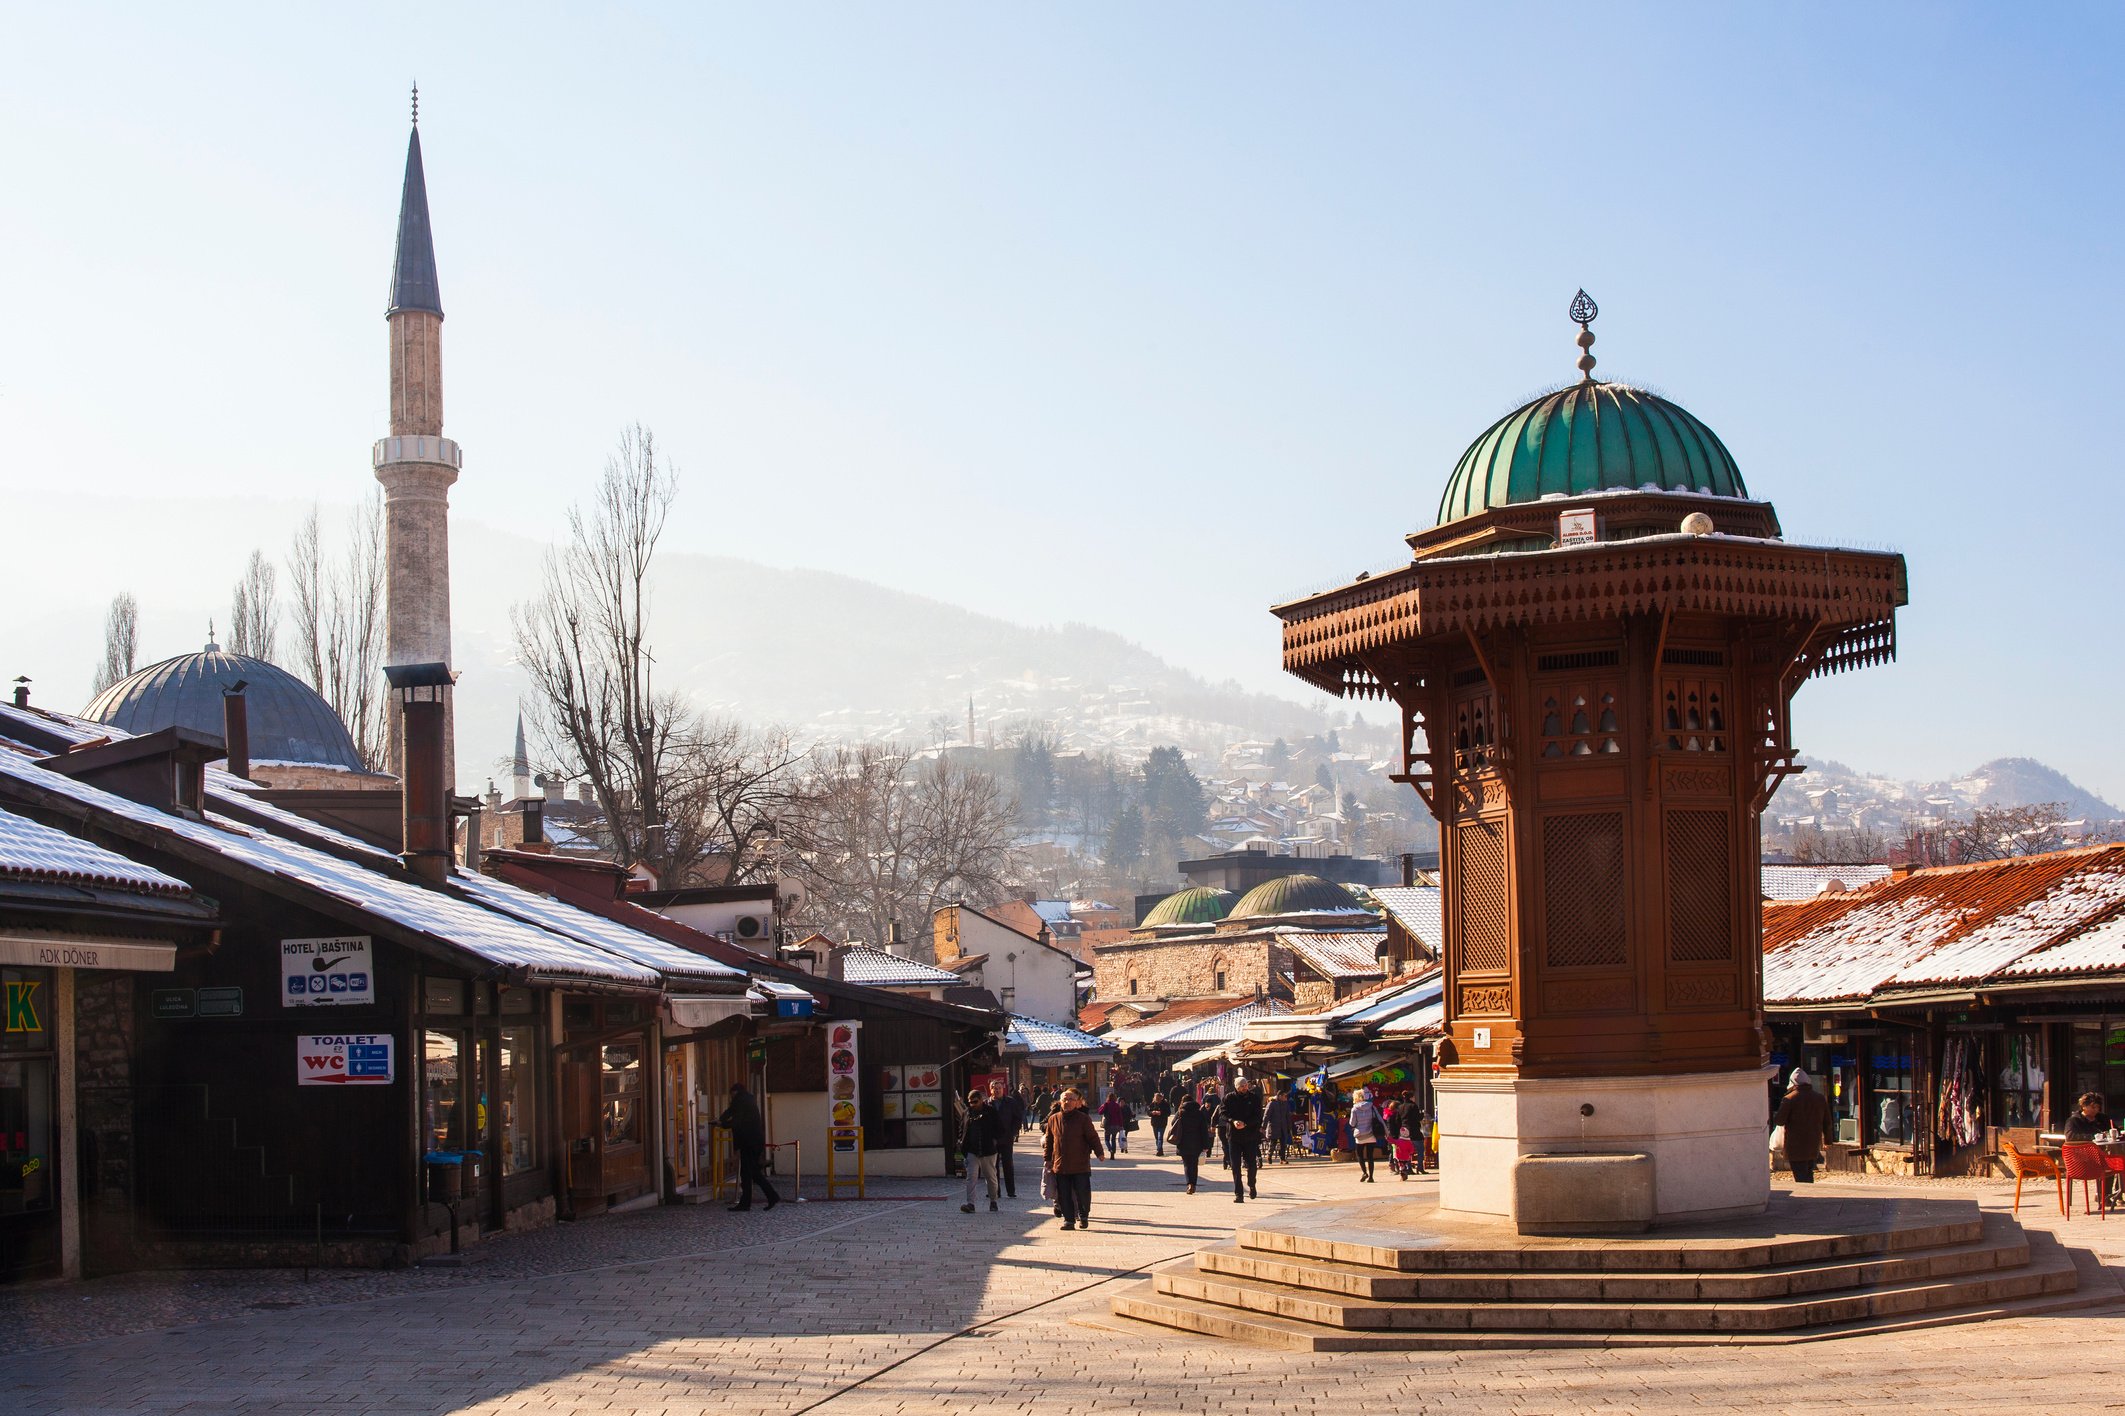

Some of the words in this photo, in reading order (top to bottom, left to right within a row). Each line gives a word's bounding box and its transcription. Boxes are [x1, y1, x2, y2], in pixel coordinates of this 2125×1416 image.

[283, 943, 314, 955] HOTEL
[321, 939, 364, 953] BAŠTINA
[40, 949, 61, 964] ADK
[63, 947, 98, 966] DÖNER
[5, 981, 42, 1032] K
[311, 1036, 377, 1045] TOALET
[302, 1055, 344, 1070] WC
[1295, 1123, 1305, 1133] 29
